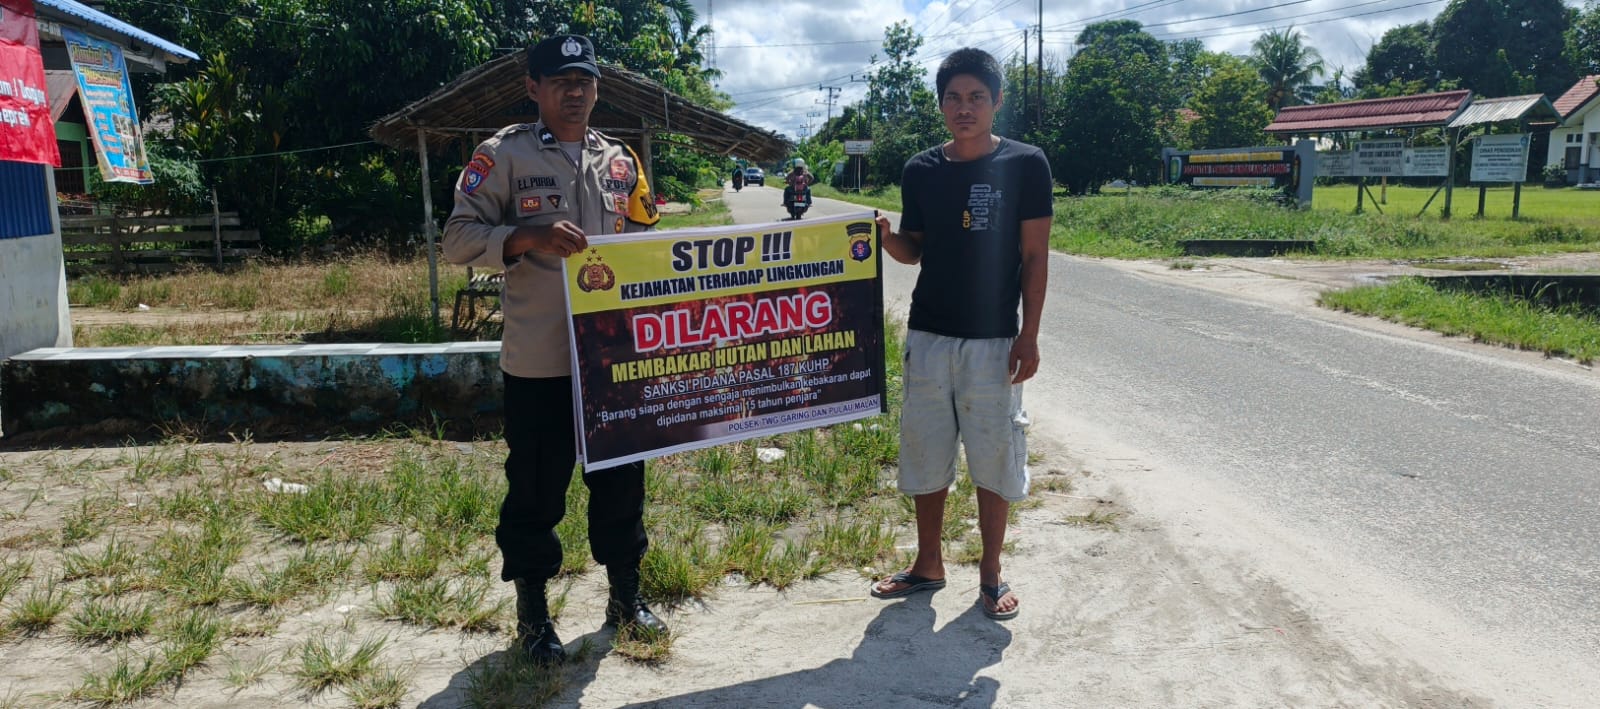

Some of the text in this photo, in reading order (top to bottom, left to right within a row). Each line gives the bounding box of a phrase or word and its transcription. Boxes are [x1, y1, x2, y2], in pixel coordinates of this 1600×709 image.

[672, 231, 792, 272] STOP !!!
[620, 259, 844, 301] KEJAHATAN TERHADAP LINGKUNGAN
[633, 291, 832, 353] DILARANG
[611, 330, 855, 383] MEMBAKAR HUTAN DAN LAHAN
[638, 401, 665, 417] siapa
[666, 395, 701, 413] dengan
[703, 389, 740, 407] sengaja
[742, 379, 801, 398] menimbulkan
[803, 373, 848, 388] kebakaran
[850, 367, 872, 382] dapat
[643, 358, 830, 399] SANKSI PIDANA PASAL 187 KUHP
[656, 410, 698, 428] dipidana
[700, 403, 743, 418] maksimal
[745, 399, 756, 411] 15
[758, 395, 783, 410] tahun
[728, 398, 878, 432] POLSEK TWG GARING DAN PULAU MALAN
